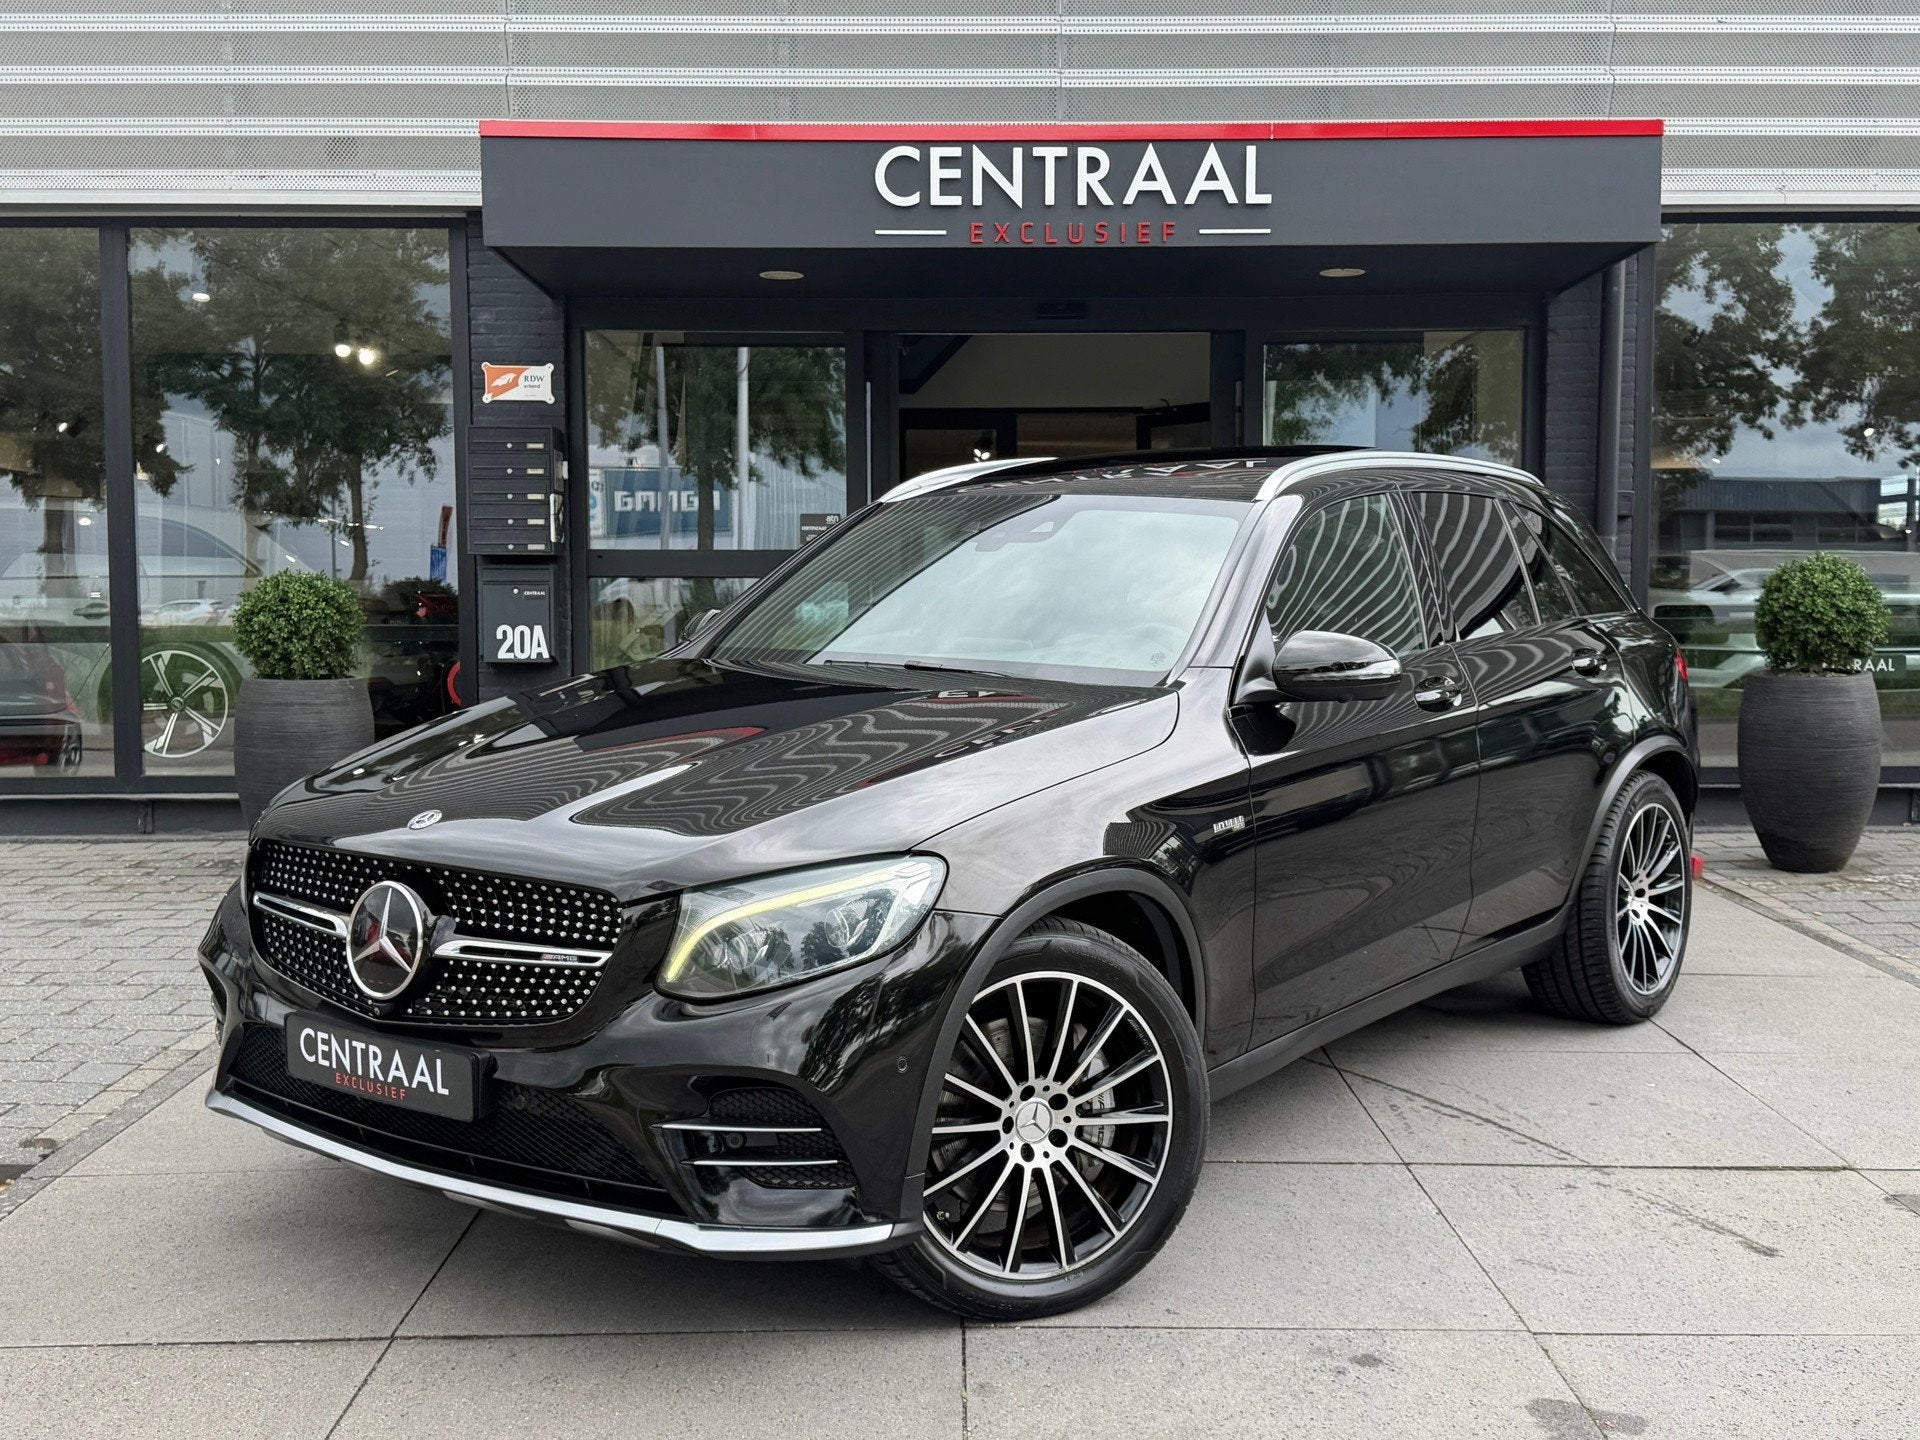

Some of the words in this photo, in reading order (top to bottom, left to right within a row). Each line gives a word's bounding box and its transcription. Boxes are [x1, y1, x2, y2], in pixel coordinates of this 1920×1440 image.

[874, 142, 1273, 209] CENTRAAL
[969, 221, 1177, 244] EXCLUSIEF
[523, 374, 545, 382] RDW
[496, 624, 550, 659] 20A
[300, 1027, 449, 1096] CENTRAAL
[335, 1071, 407, 1101] EXCLUSIEF
